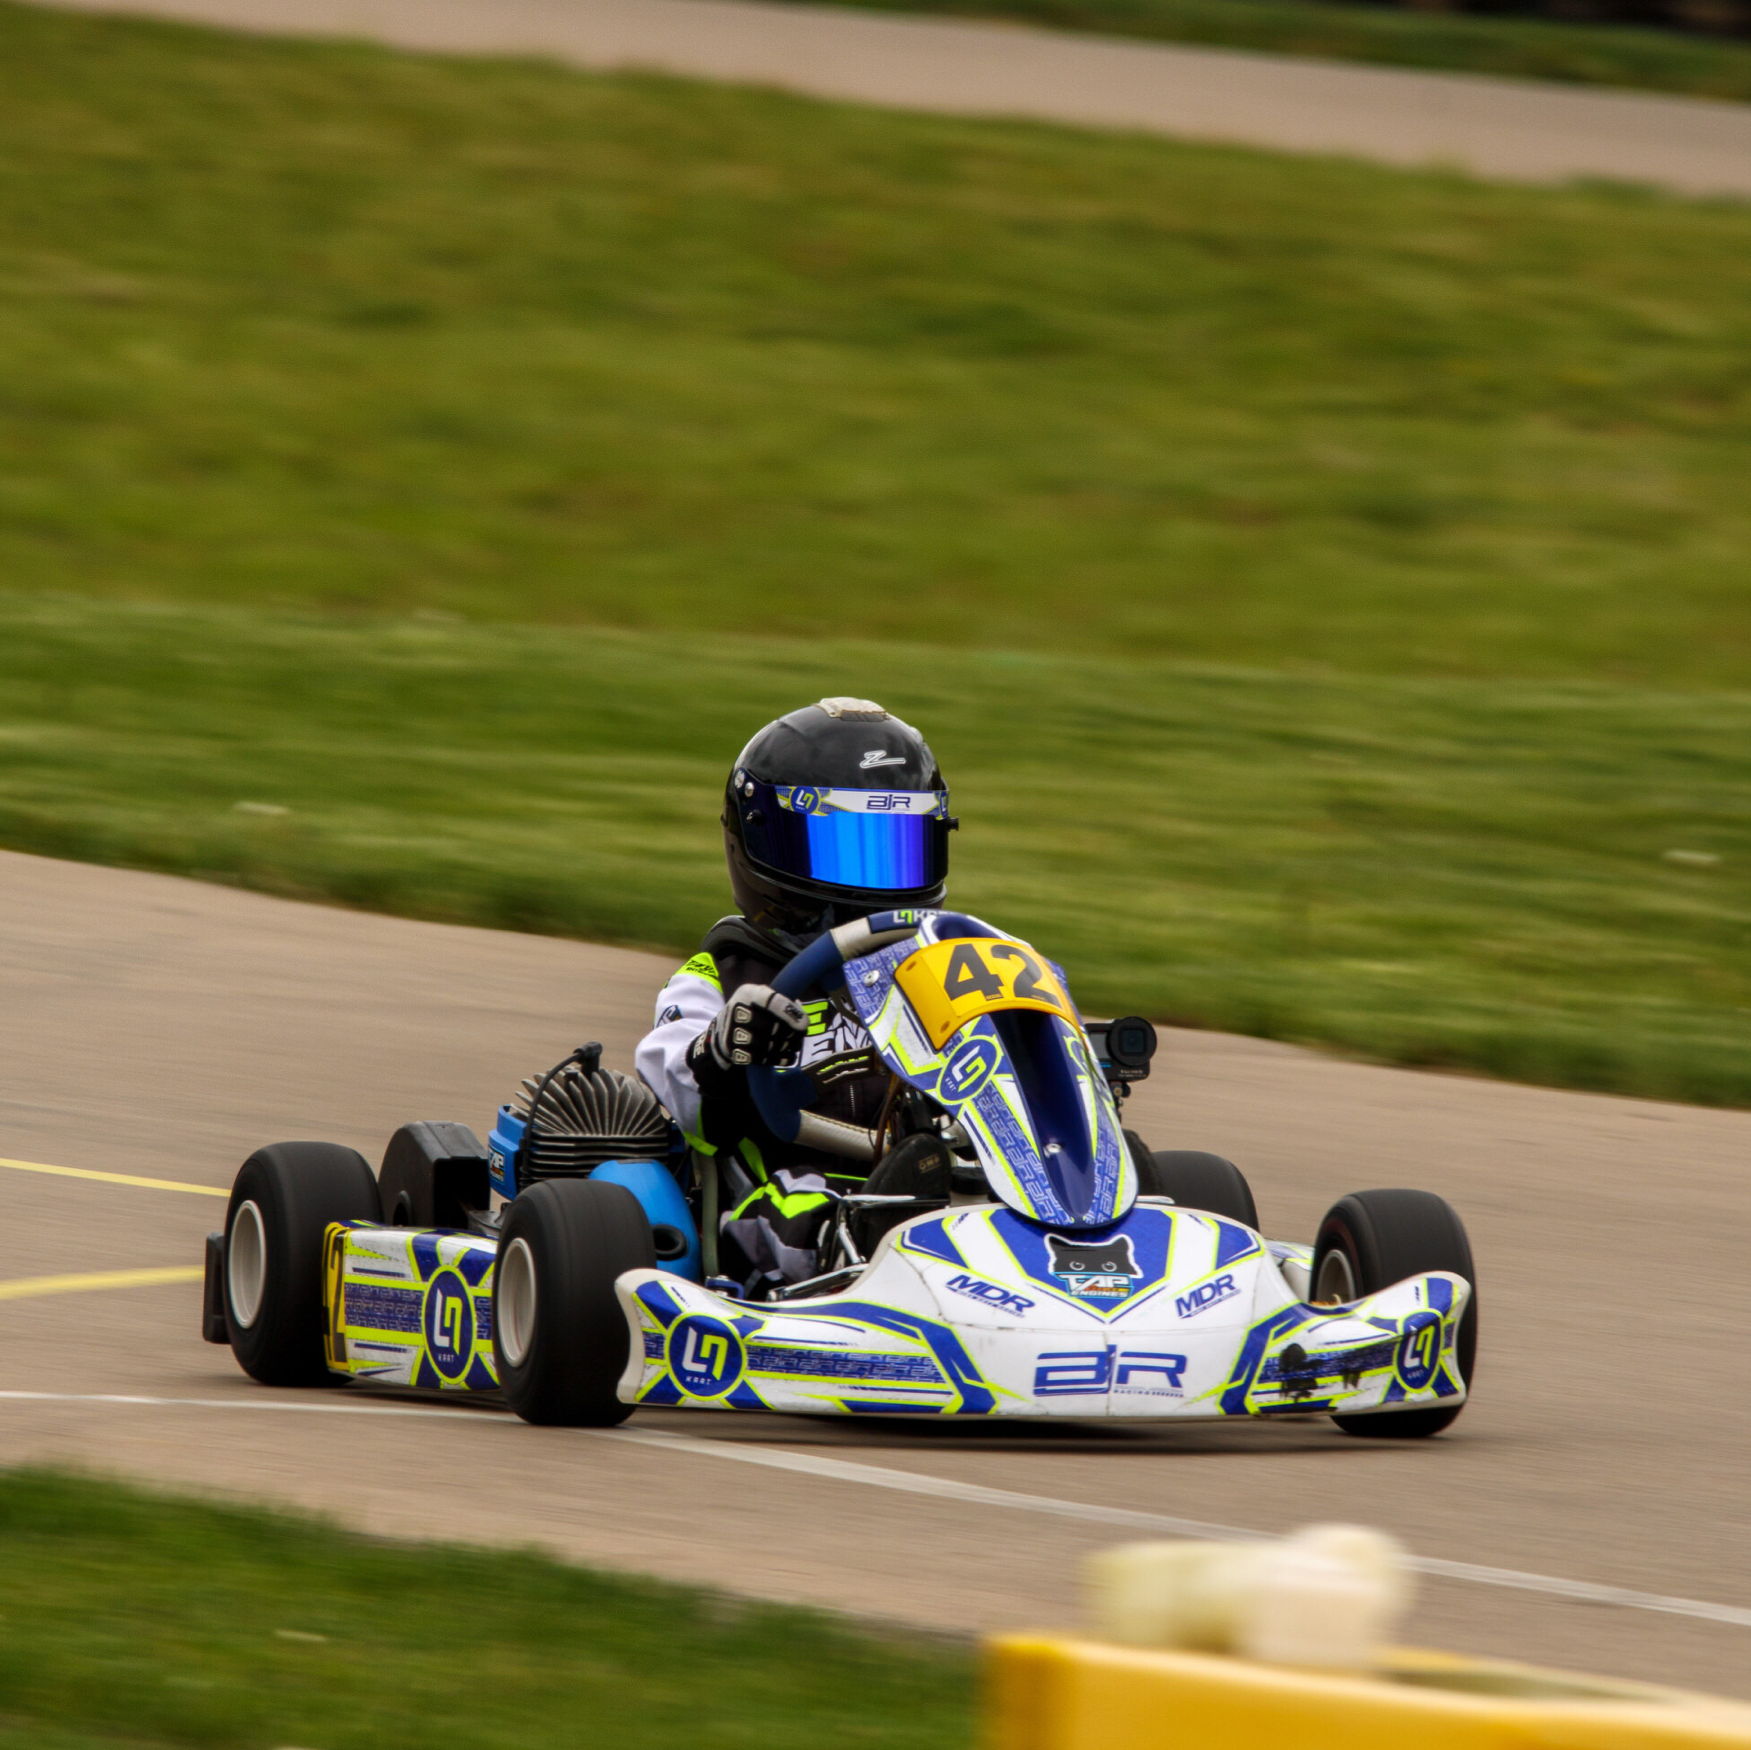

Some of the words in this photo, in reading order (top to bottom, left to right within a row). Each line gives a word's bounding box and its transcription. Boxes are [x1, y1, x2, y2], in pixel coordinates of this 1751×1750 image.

[943, 943, 1060, 1009] 42
[946, 1275, 1036, 1313] MDR
[1175, 1274, 1236, 1316] MDR
